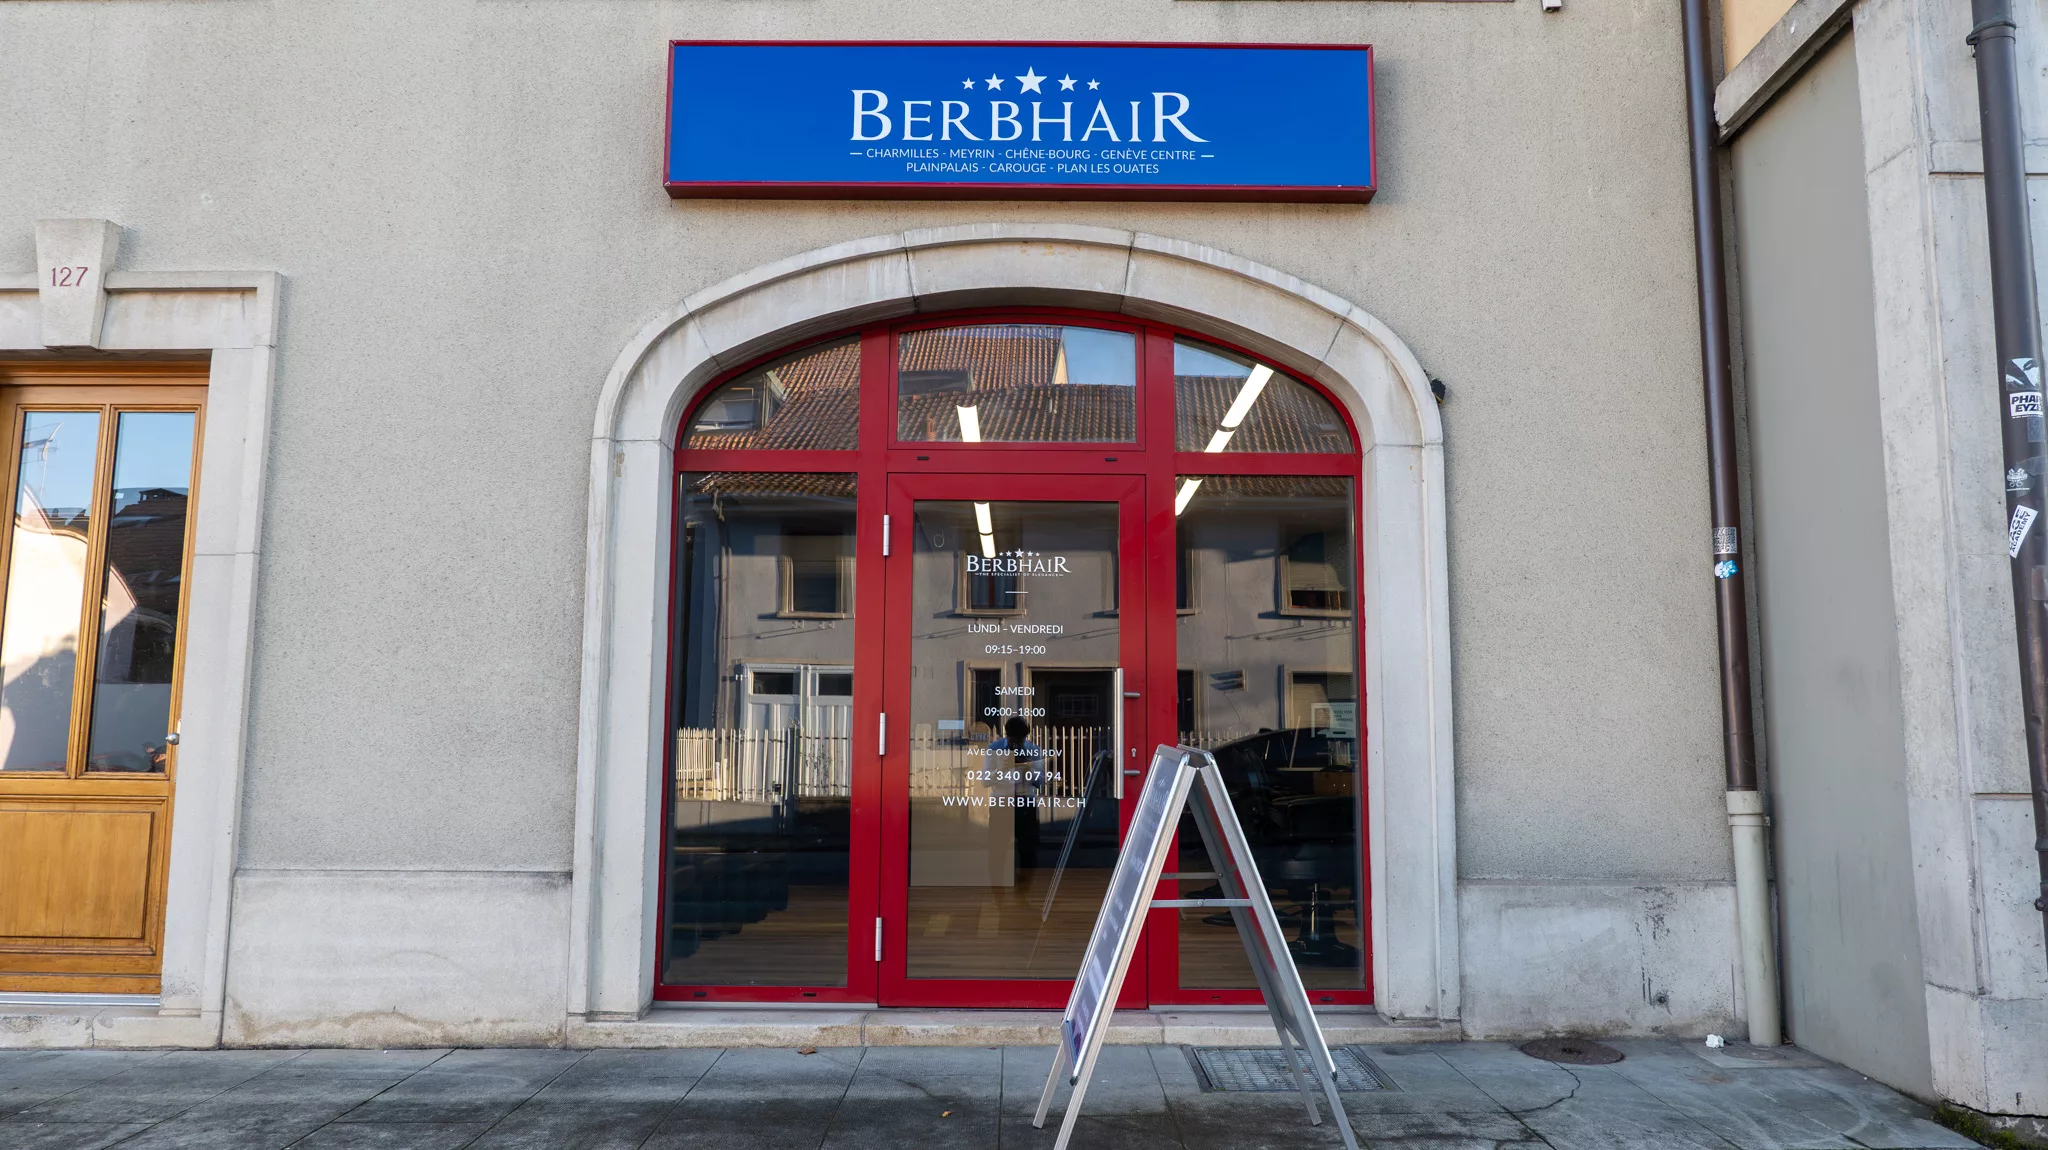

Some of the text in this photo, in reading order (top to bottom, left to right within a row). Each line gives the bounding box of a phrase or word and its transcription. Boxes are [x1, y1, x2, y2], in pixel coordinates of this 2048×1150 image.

[850, 89, 1211, 143] BERBHAIR
[866, 148, 939, 159] CHARMILLES
[949, 149, 995, 159] MEYRIN
[1005, 147, 1091, 160] CHÊNE-BOURG
[1100, 148, 1148, 160] GENÈVE
[1150, 150, 1196, 160] CENTRE
[906, 162, 979, 173] PLAINPALAIS
[989, 163, 1047, 174] CAROUGE
[1057, 163, 1087, 174] PLAN
[1091, 163, 1111, 174] LES
[1114, 163, 1159, 174] OUATES
[51, 267, 88, 287] 127
[2011, 395, 2041, 404] PHA
[966, 555, 1072, 573] BERBHAIR
[968, 624, 1000, 634] LUNDI
[1011, 625, 1064, 634] VENDREDI
[995, 686, 1035, 696] SAMEDI
[967, 748, 1063, 757] AVEC OU SANS RDV
[967, 770, 1062, 781] 022 340 07 94
[942, 796, 1086, 808] WWW.BERBHAIR.CH
